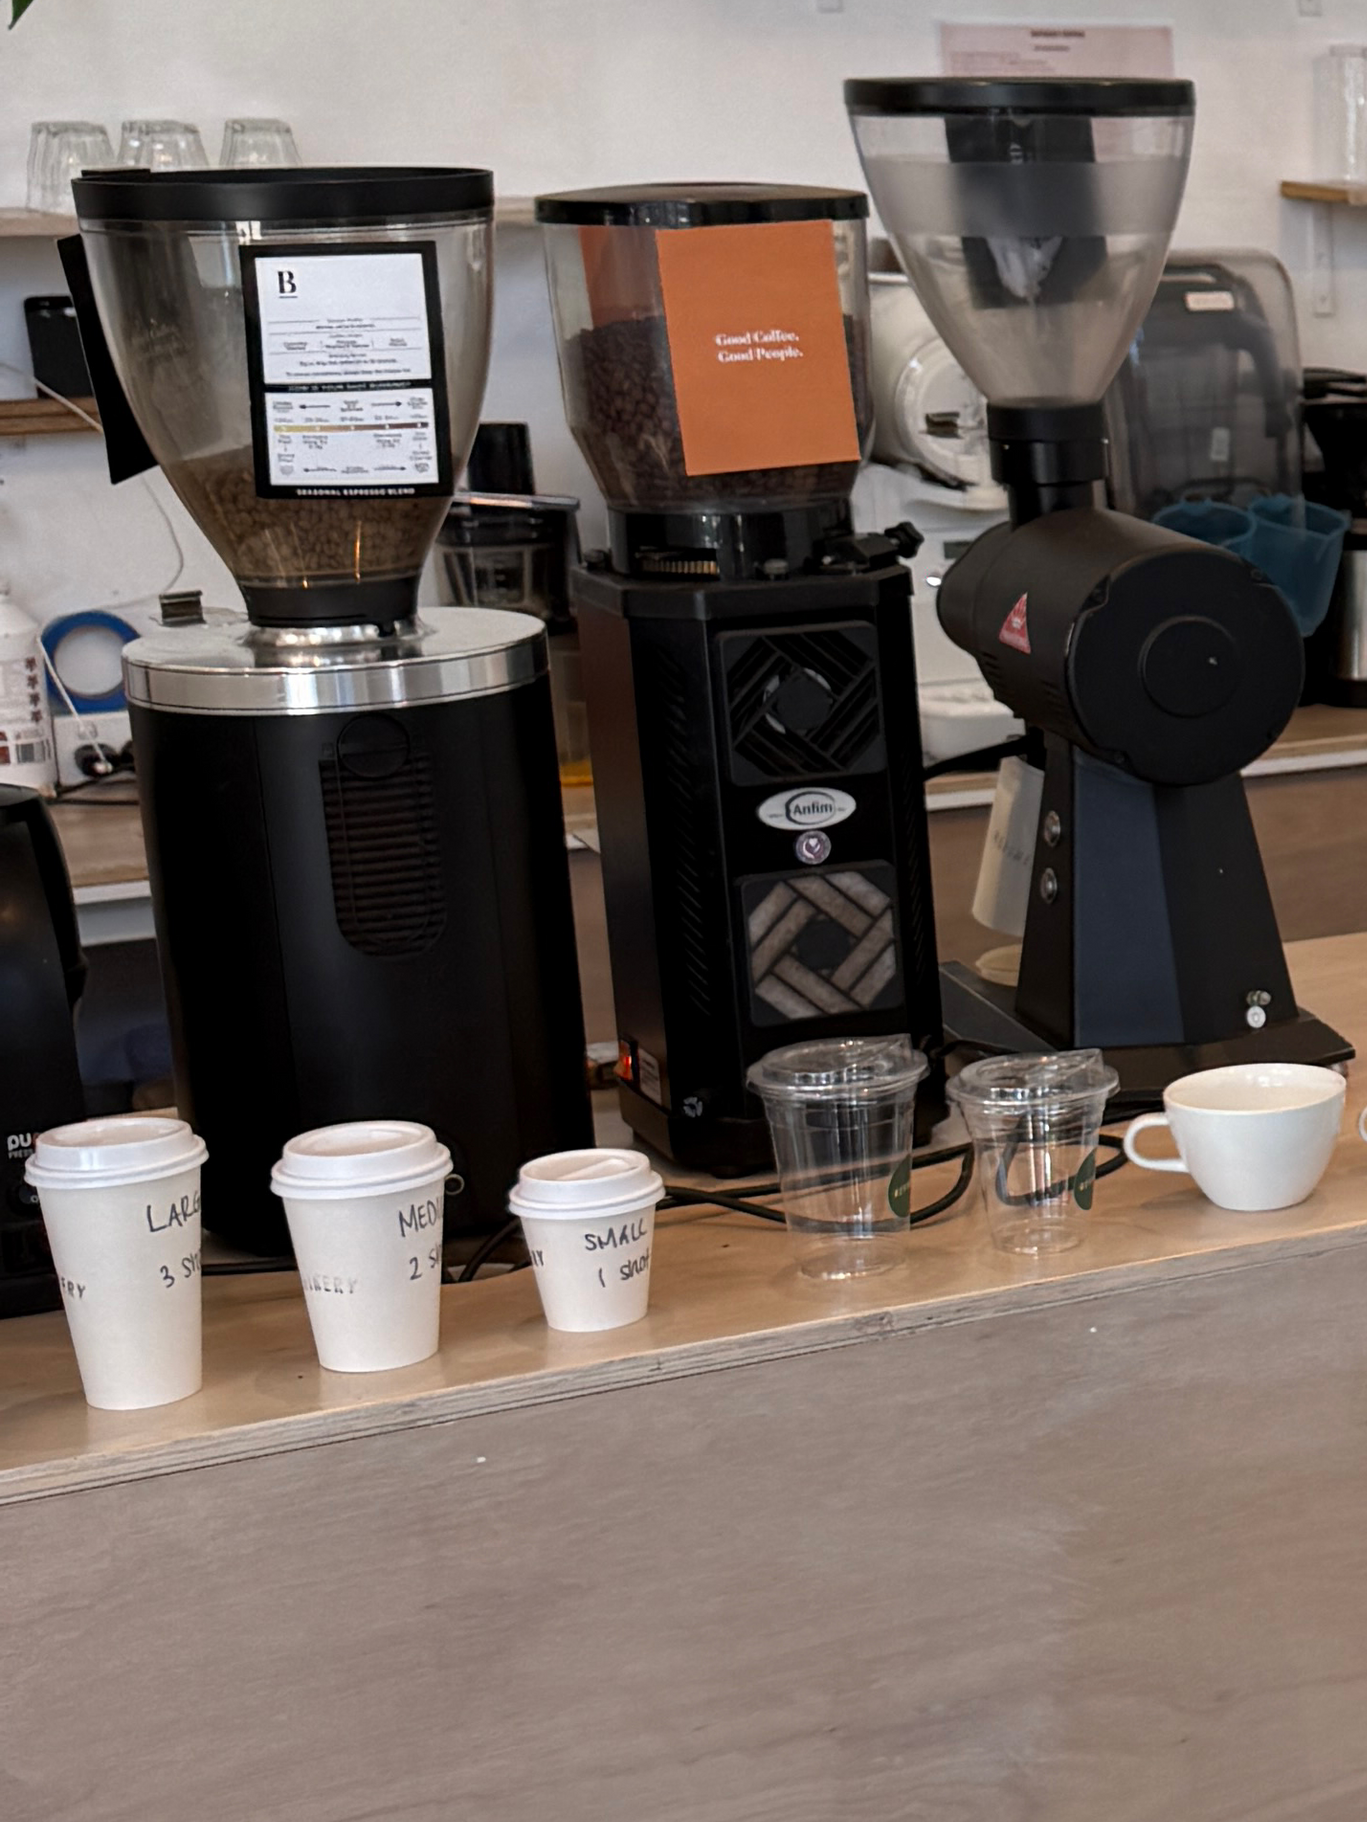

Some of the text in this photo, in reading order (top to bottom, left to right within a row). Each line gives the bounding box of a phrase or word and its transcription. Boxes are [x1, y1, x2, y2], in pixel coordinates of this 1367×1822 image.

[277, 270, 298, 294] B
[716, 329, 799, 346] Good Coffee.
[718, 346, 803, 362] Good People.
[793, 801, 833, 816] Anfim
[584, 1218, 648, 1251] SMALL
[160, 1265, 175, 1288] 3
[409, 1256, 422, 1280] 2
